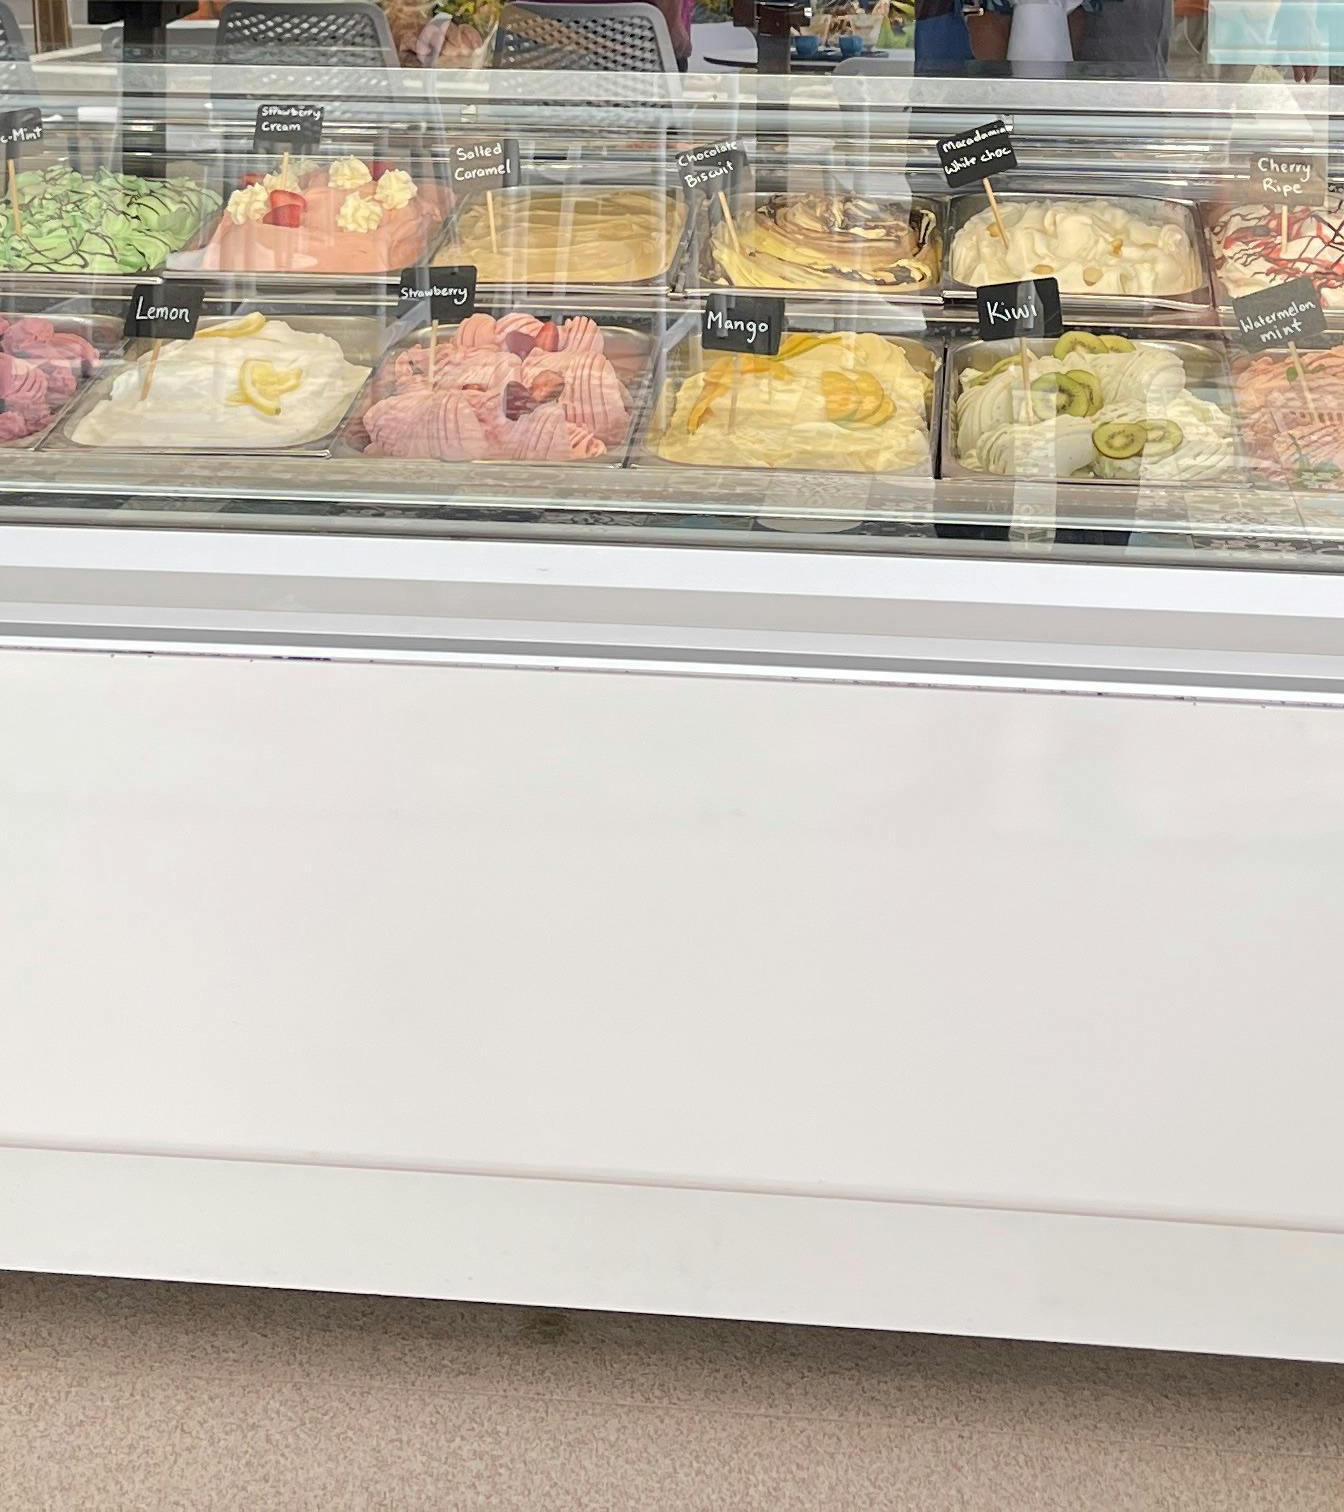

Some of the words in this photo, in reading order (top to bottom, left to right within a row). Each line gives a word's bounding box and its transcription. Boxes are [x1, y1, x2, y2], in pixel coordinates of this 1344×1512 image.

[261, 121, 301, 131] Cream
[456, 142, 502, 162] Salted
[678, 140, 738, 167] Chocolate
[454, 159, 511, 181] Caramel
[684, 161, 734, 188] Biscuit
[1258, 157, 1311, 182] Cherry
[1263, 178, 1303, 198] Ripe
[400, 283, 468, 306] Strawberry
[135, 295, 191, 326] Lemon
[986, 296, 1039, 324] Kiwi
[1240, 300, 1316, 334] Watermelon
[706, 308, 769, 344] Mango
[1260, 318, 1303, 343] mint
